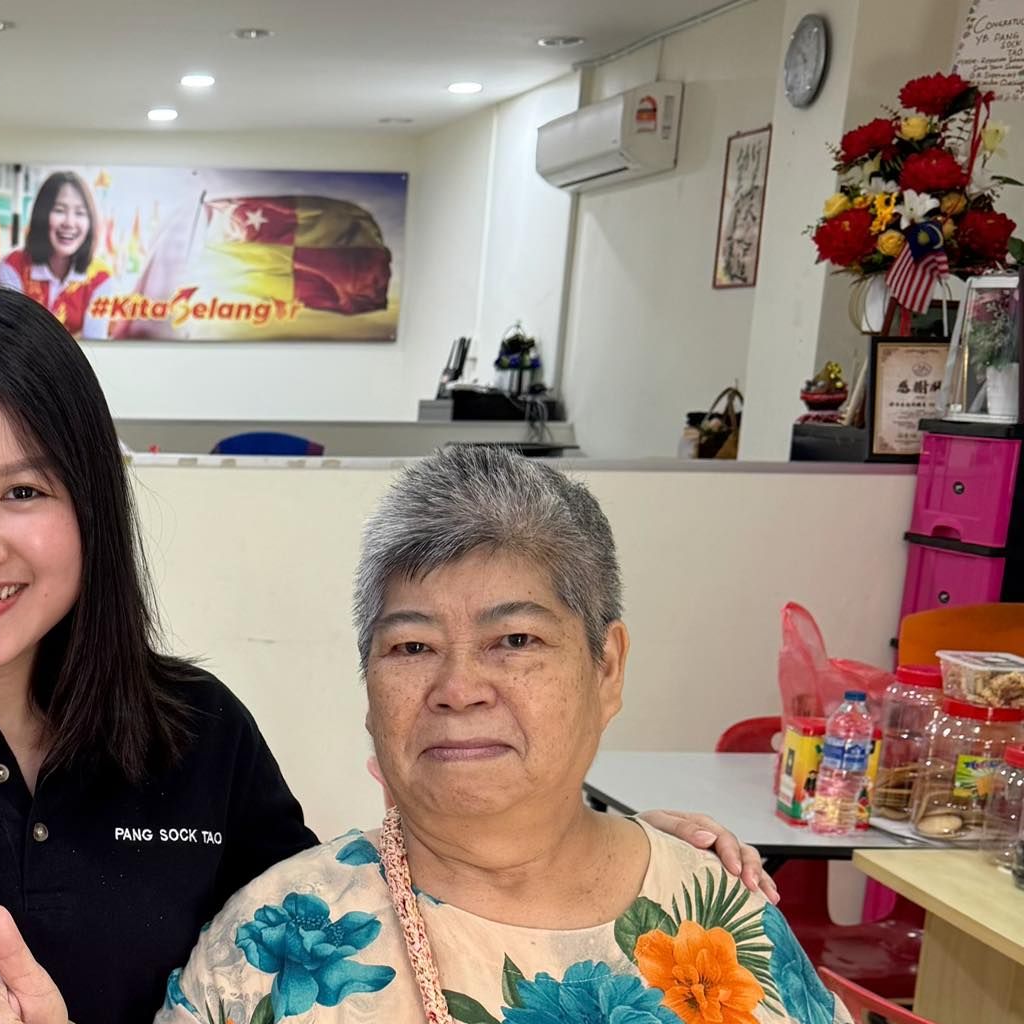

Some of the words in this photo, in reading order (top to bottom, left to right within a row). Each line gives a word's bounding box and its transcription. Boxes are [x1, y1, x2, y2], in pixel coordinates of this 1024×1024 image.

[114, 827, 154, 841] PANG
[159, 828, 198, 843] SOCK
[201, 830, 223, 845] TAO
